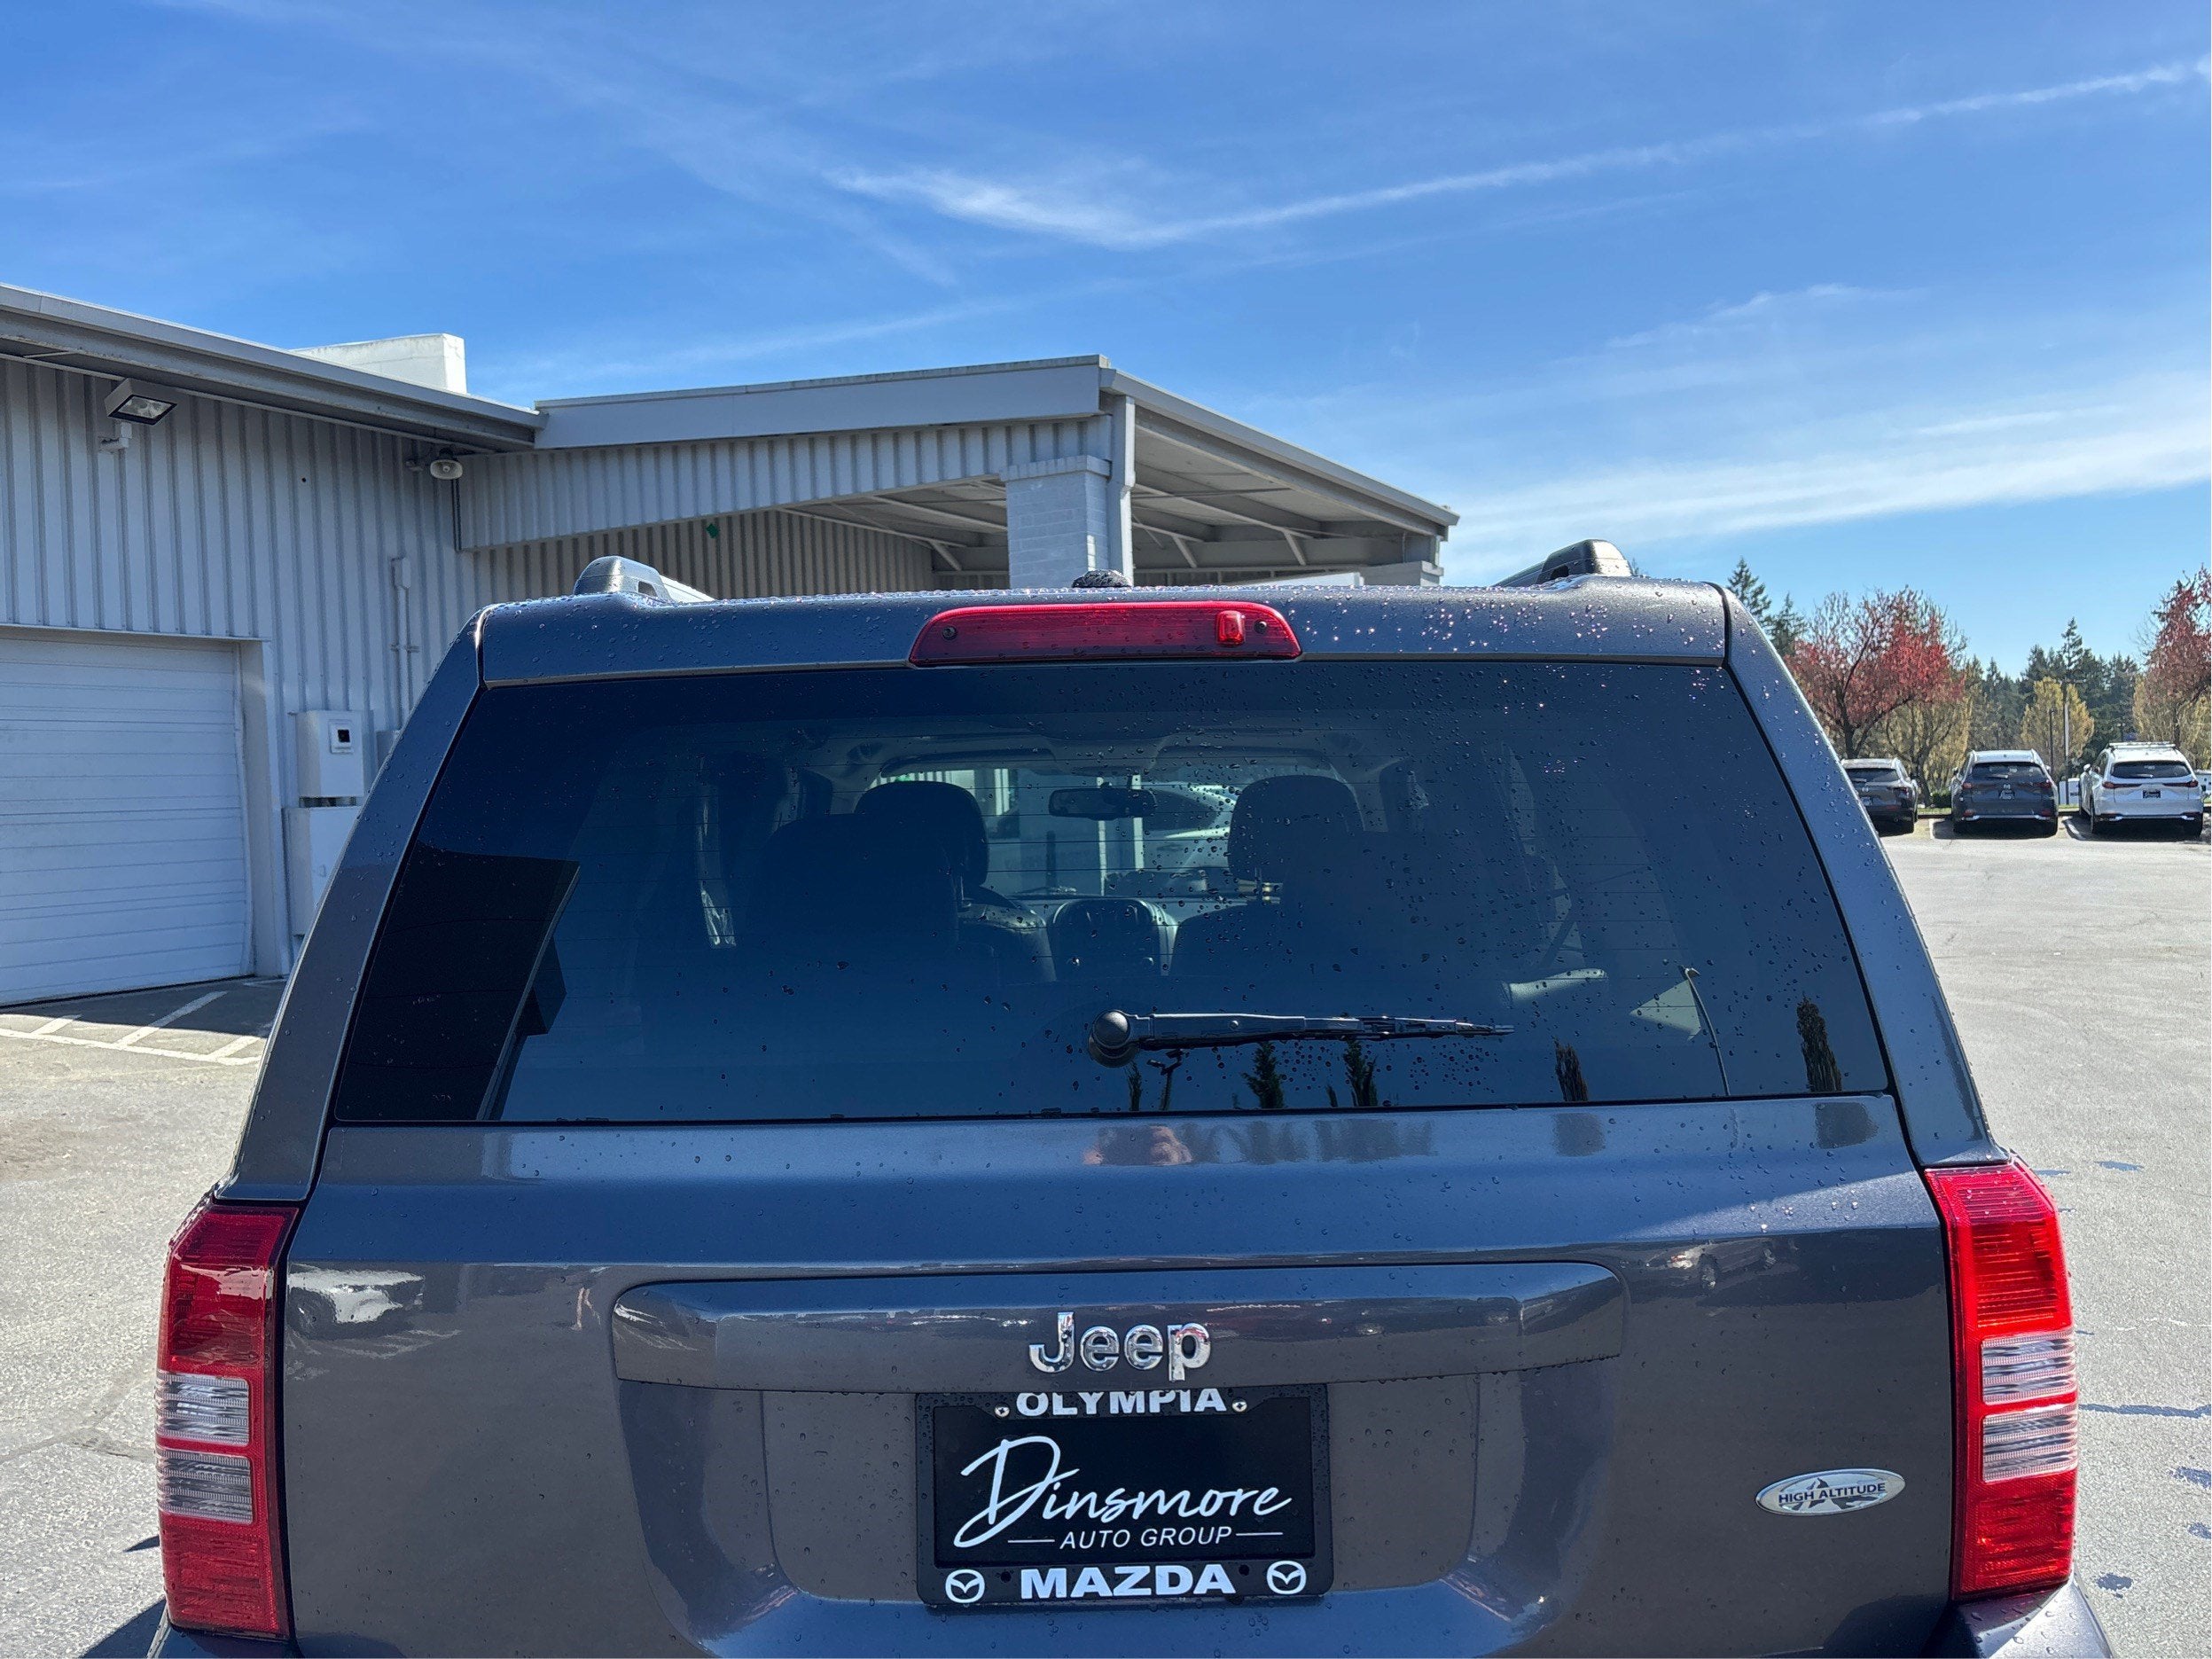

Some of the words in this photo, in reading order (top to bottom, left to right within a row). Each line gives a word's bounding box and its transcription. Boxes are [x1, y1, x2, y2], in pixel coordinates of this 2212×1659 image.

[1028, 1311, 1212, 1381] Jeep
[1016, 1388, 1227, 1417] OLYMPIA
[953, 1436, 1293, 1548] Dinsmore
[1778, 1491, 1814, 1504] HIGH
[1818, 1483, 1887, 1500] ALTITUDE
[1059, 1530, 1130, 1550] AUTO
[1140, 1526, 1232, 1548] GROUP
[1020, 1563, 1237, 1600] MAZDA
